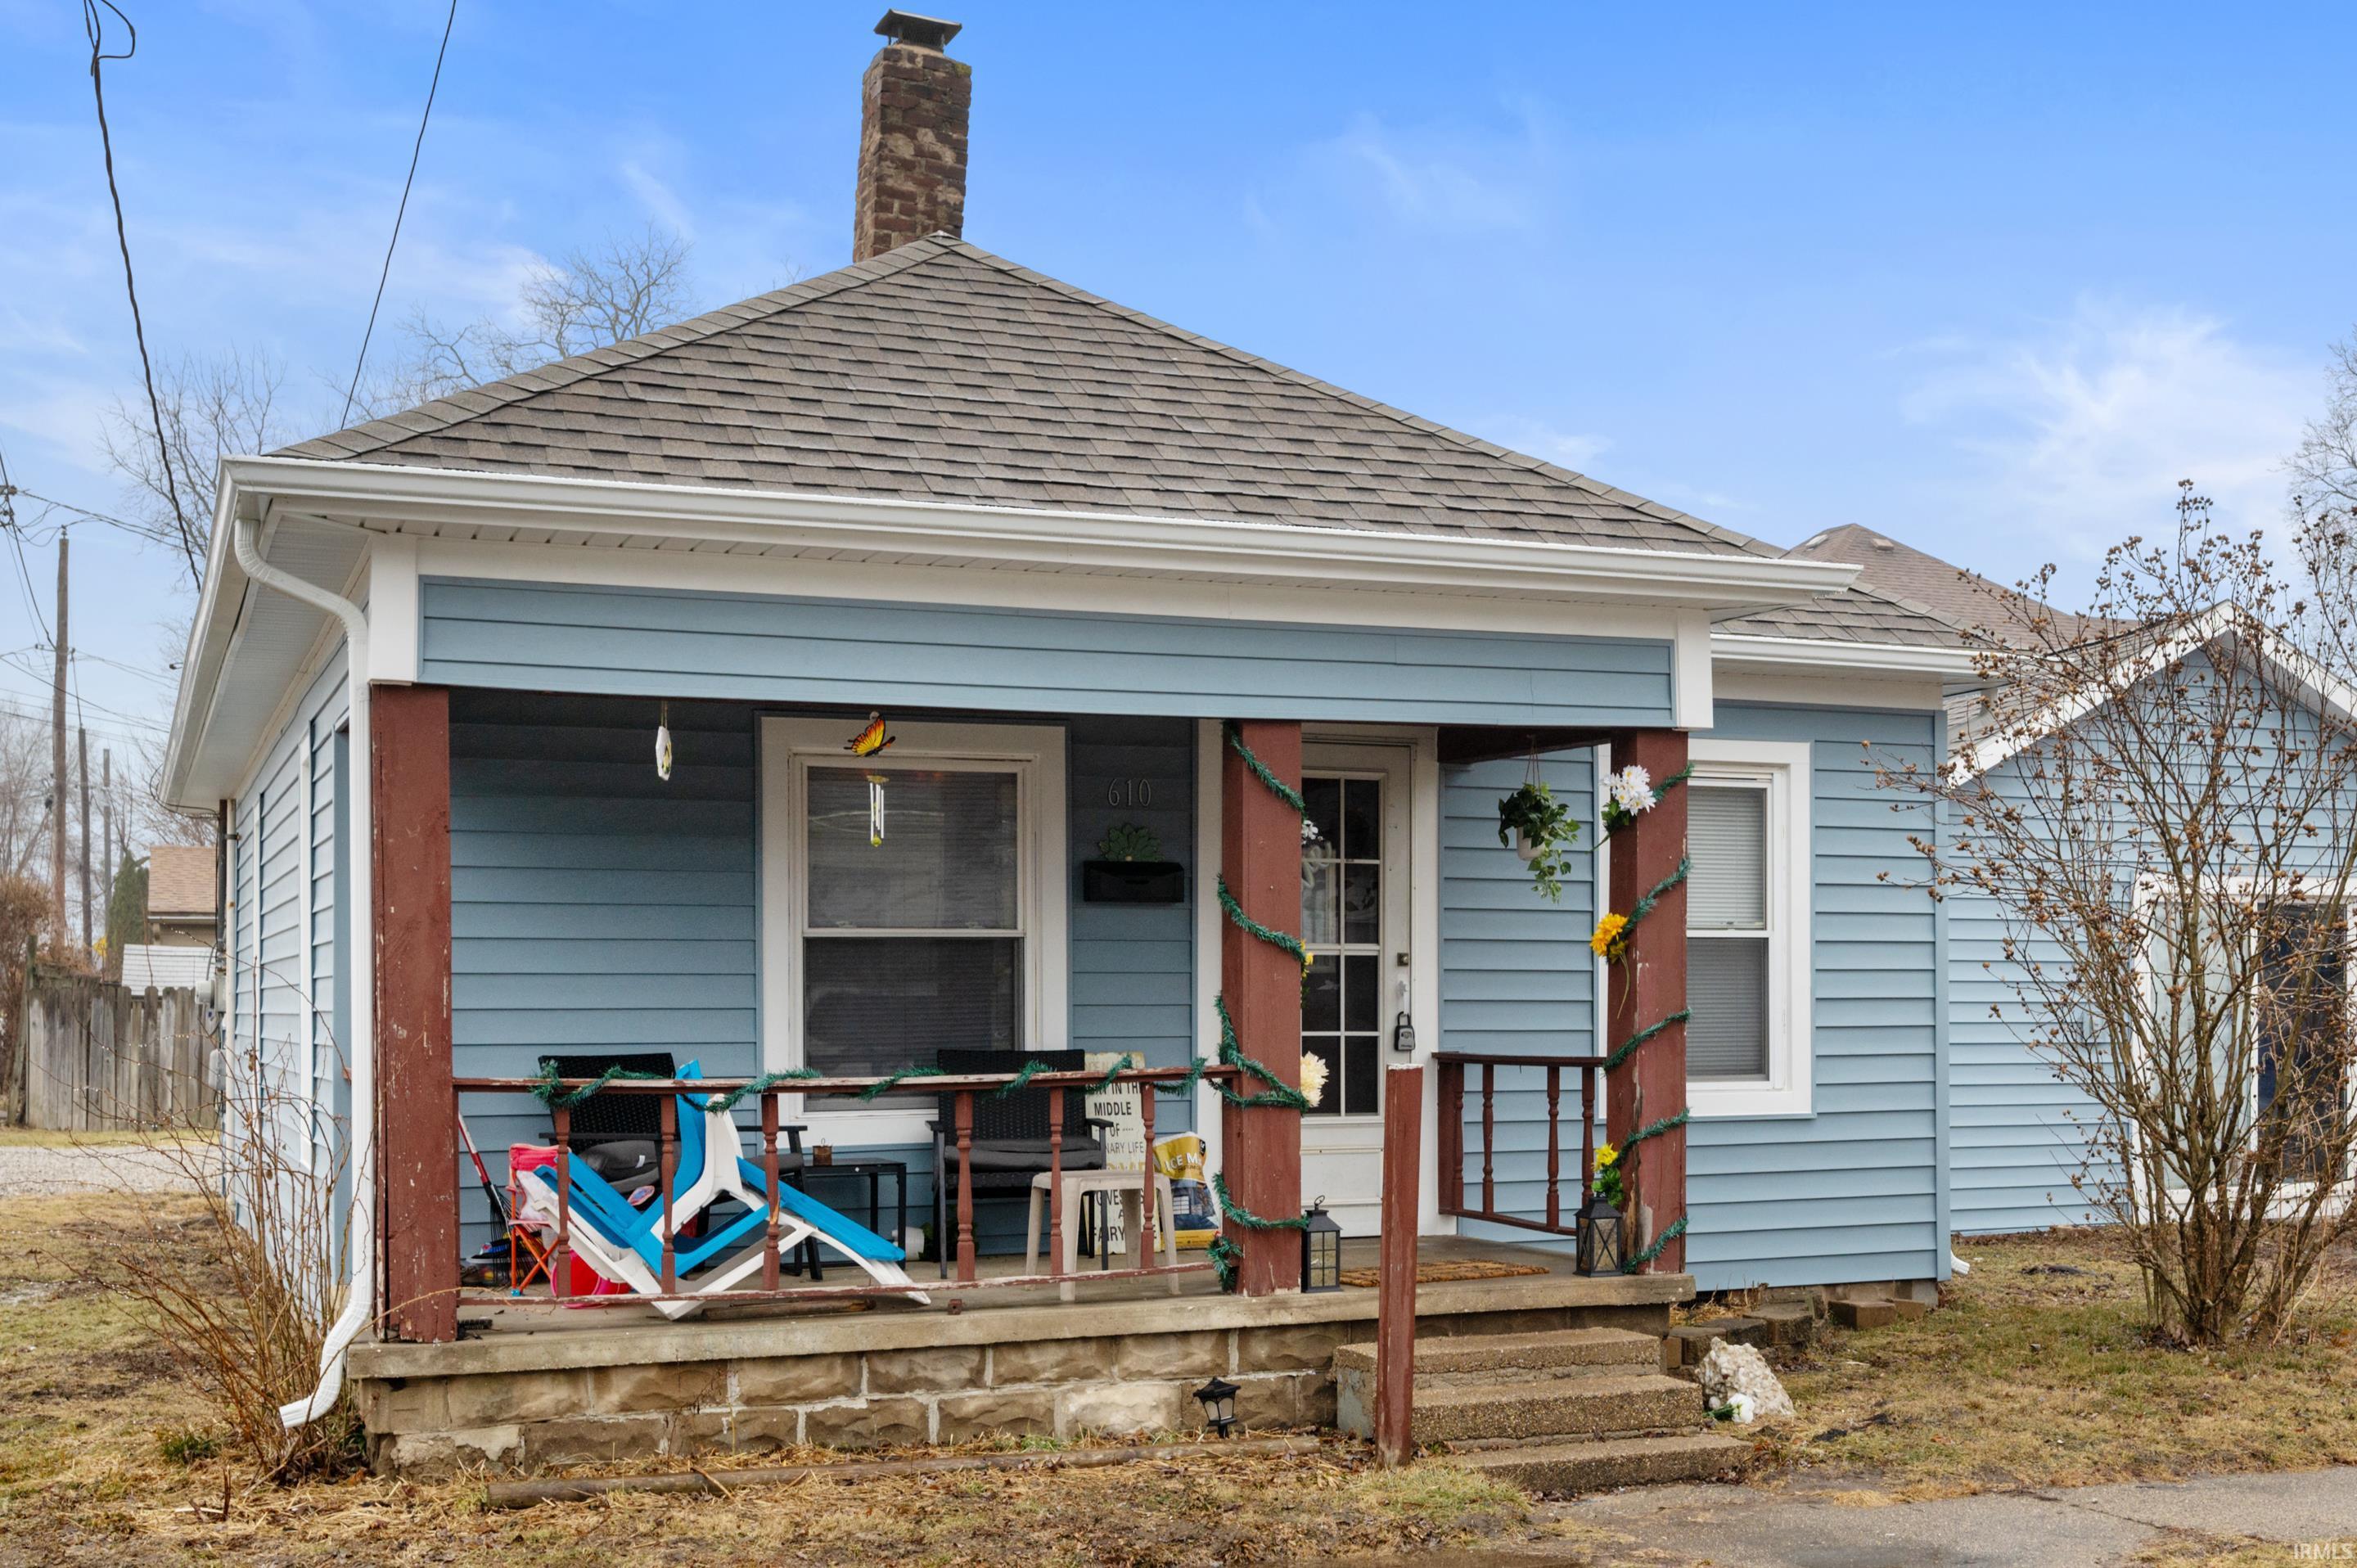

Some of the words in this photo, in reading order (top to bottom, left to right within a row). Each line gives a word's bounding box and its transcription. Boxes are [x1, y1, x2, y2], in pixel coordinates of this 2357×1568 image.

[1108, 778, 1151, 807] 610
[1112, 1081, 1122, 1094] IN
[1094, 1102, 1132, 1116] MIDDLE
[1109, 1123, 1120, 1137] OF
[1106, 1142, 1124, 1154] NARY
[1127, 1142, 1144, 1153] LIFE
[1164, 1154, 1183, 1172] ICE
[1093, 1226, 1124, 1241] ARY
